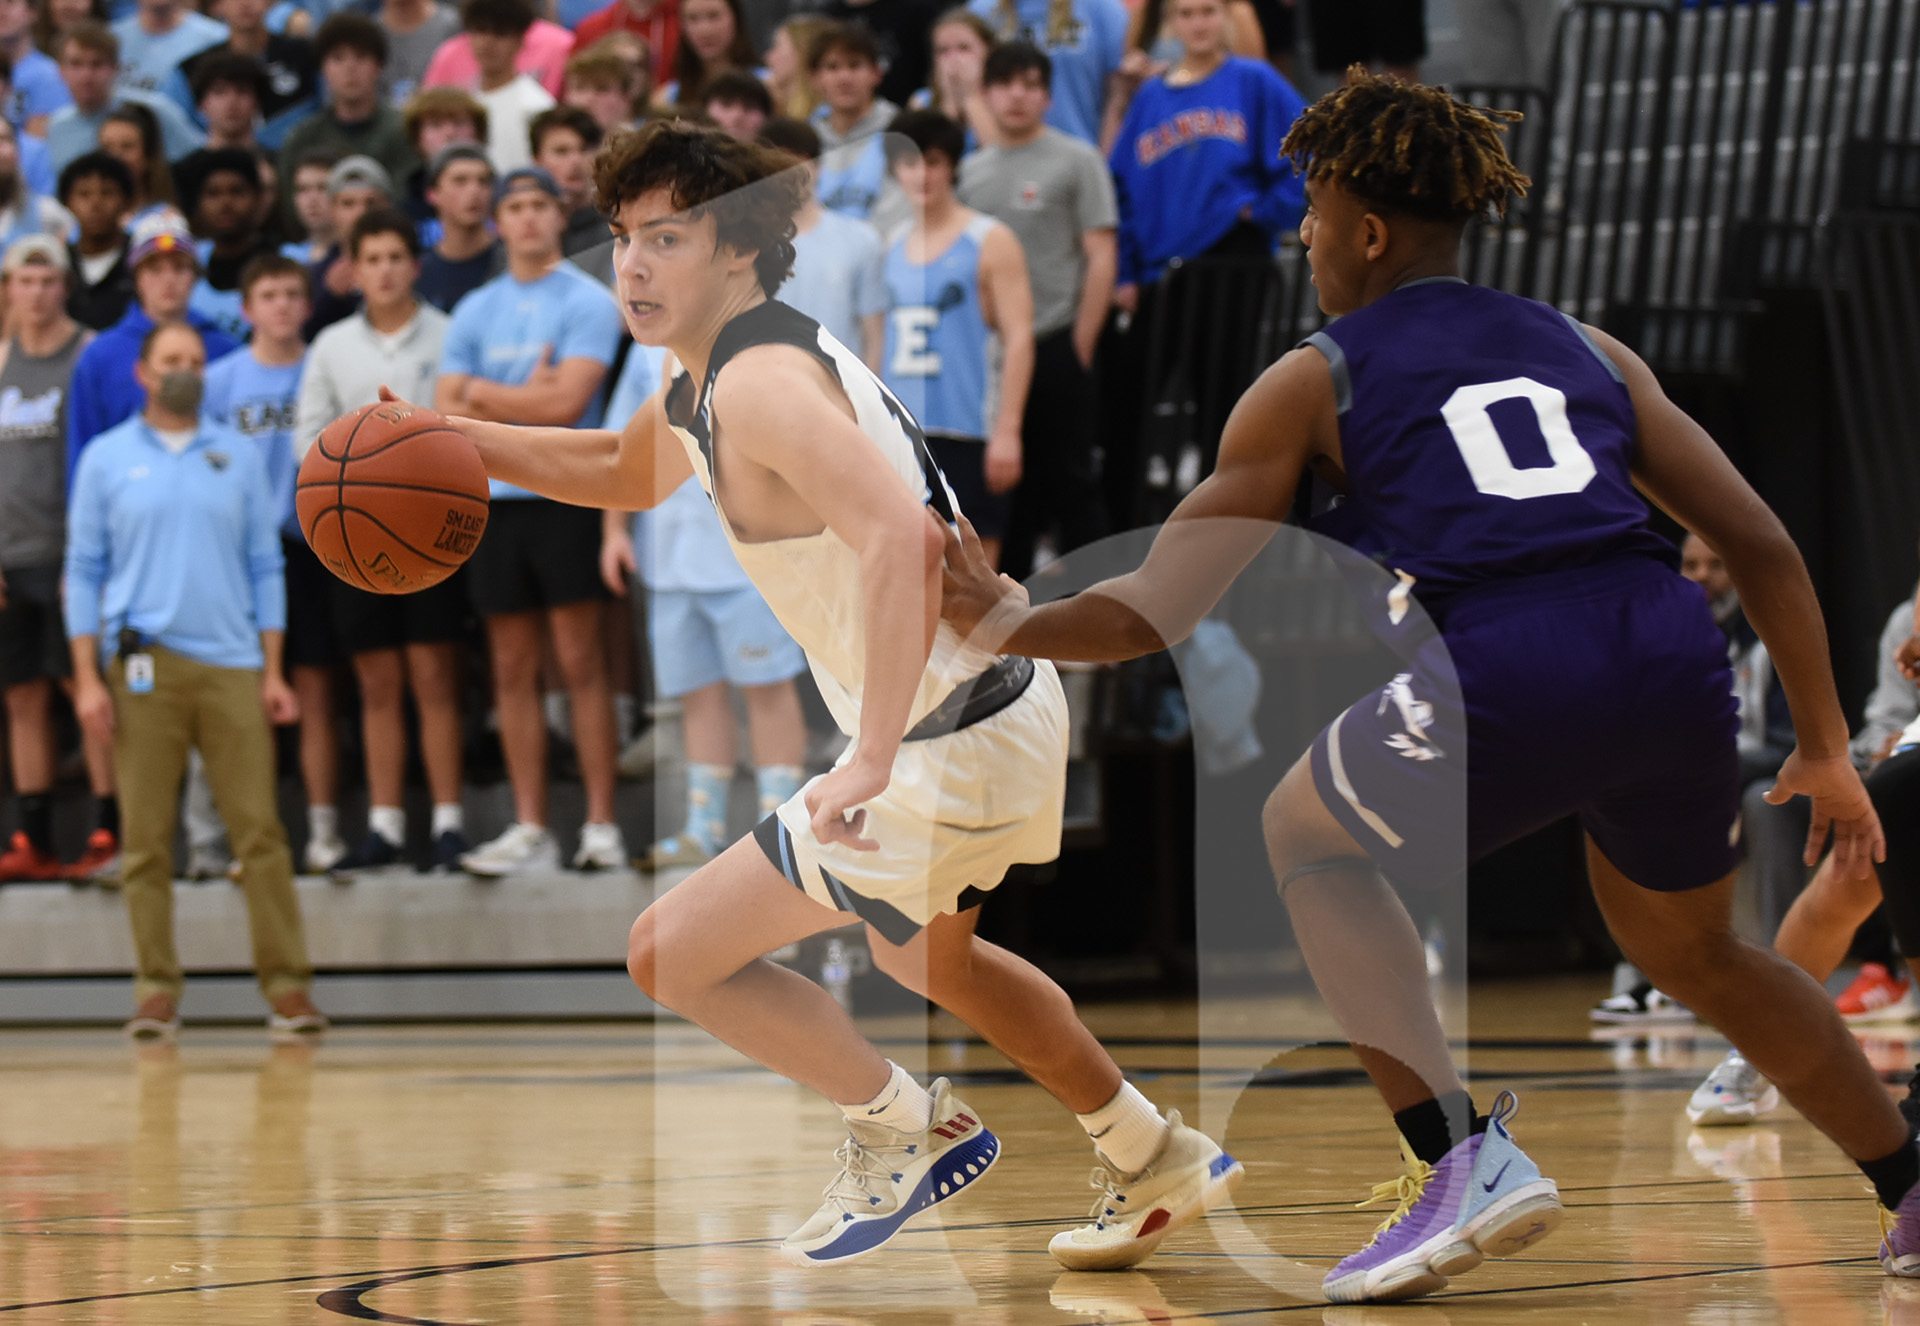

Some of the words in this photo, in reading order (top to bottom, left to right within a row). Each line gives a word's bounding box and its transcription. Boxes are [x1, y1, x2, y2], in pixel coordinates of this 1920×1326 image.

[1136, 107, 1248, 166] KANSAS
[893, 306, 942, 376] E
[445, 508, 465, 528] SM
